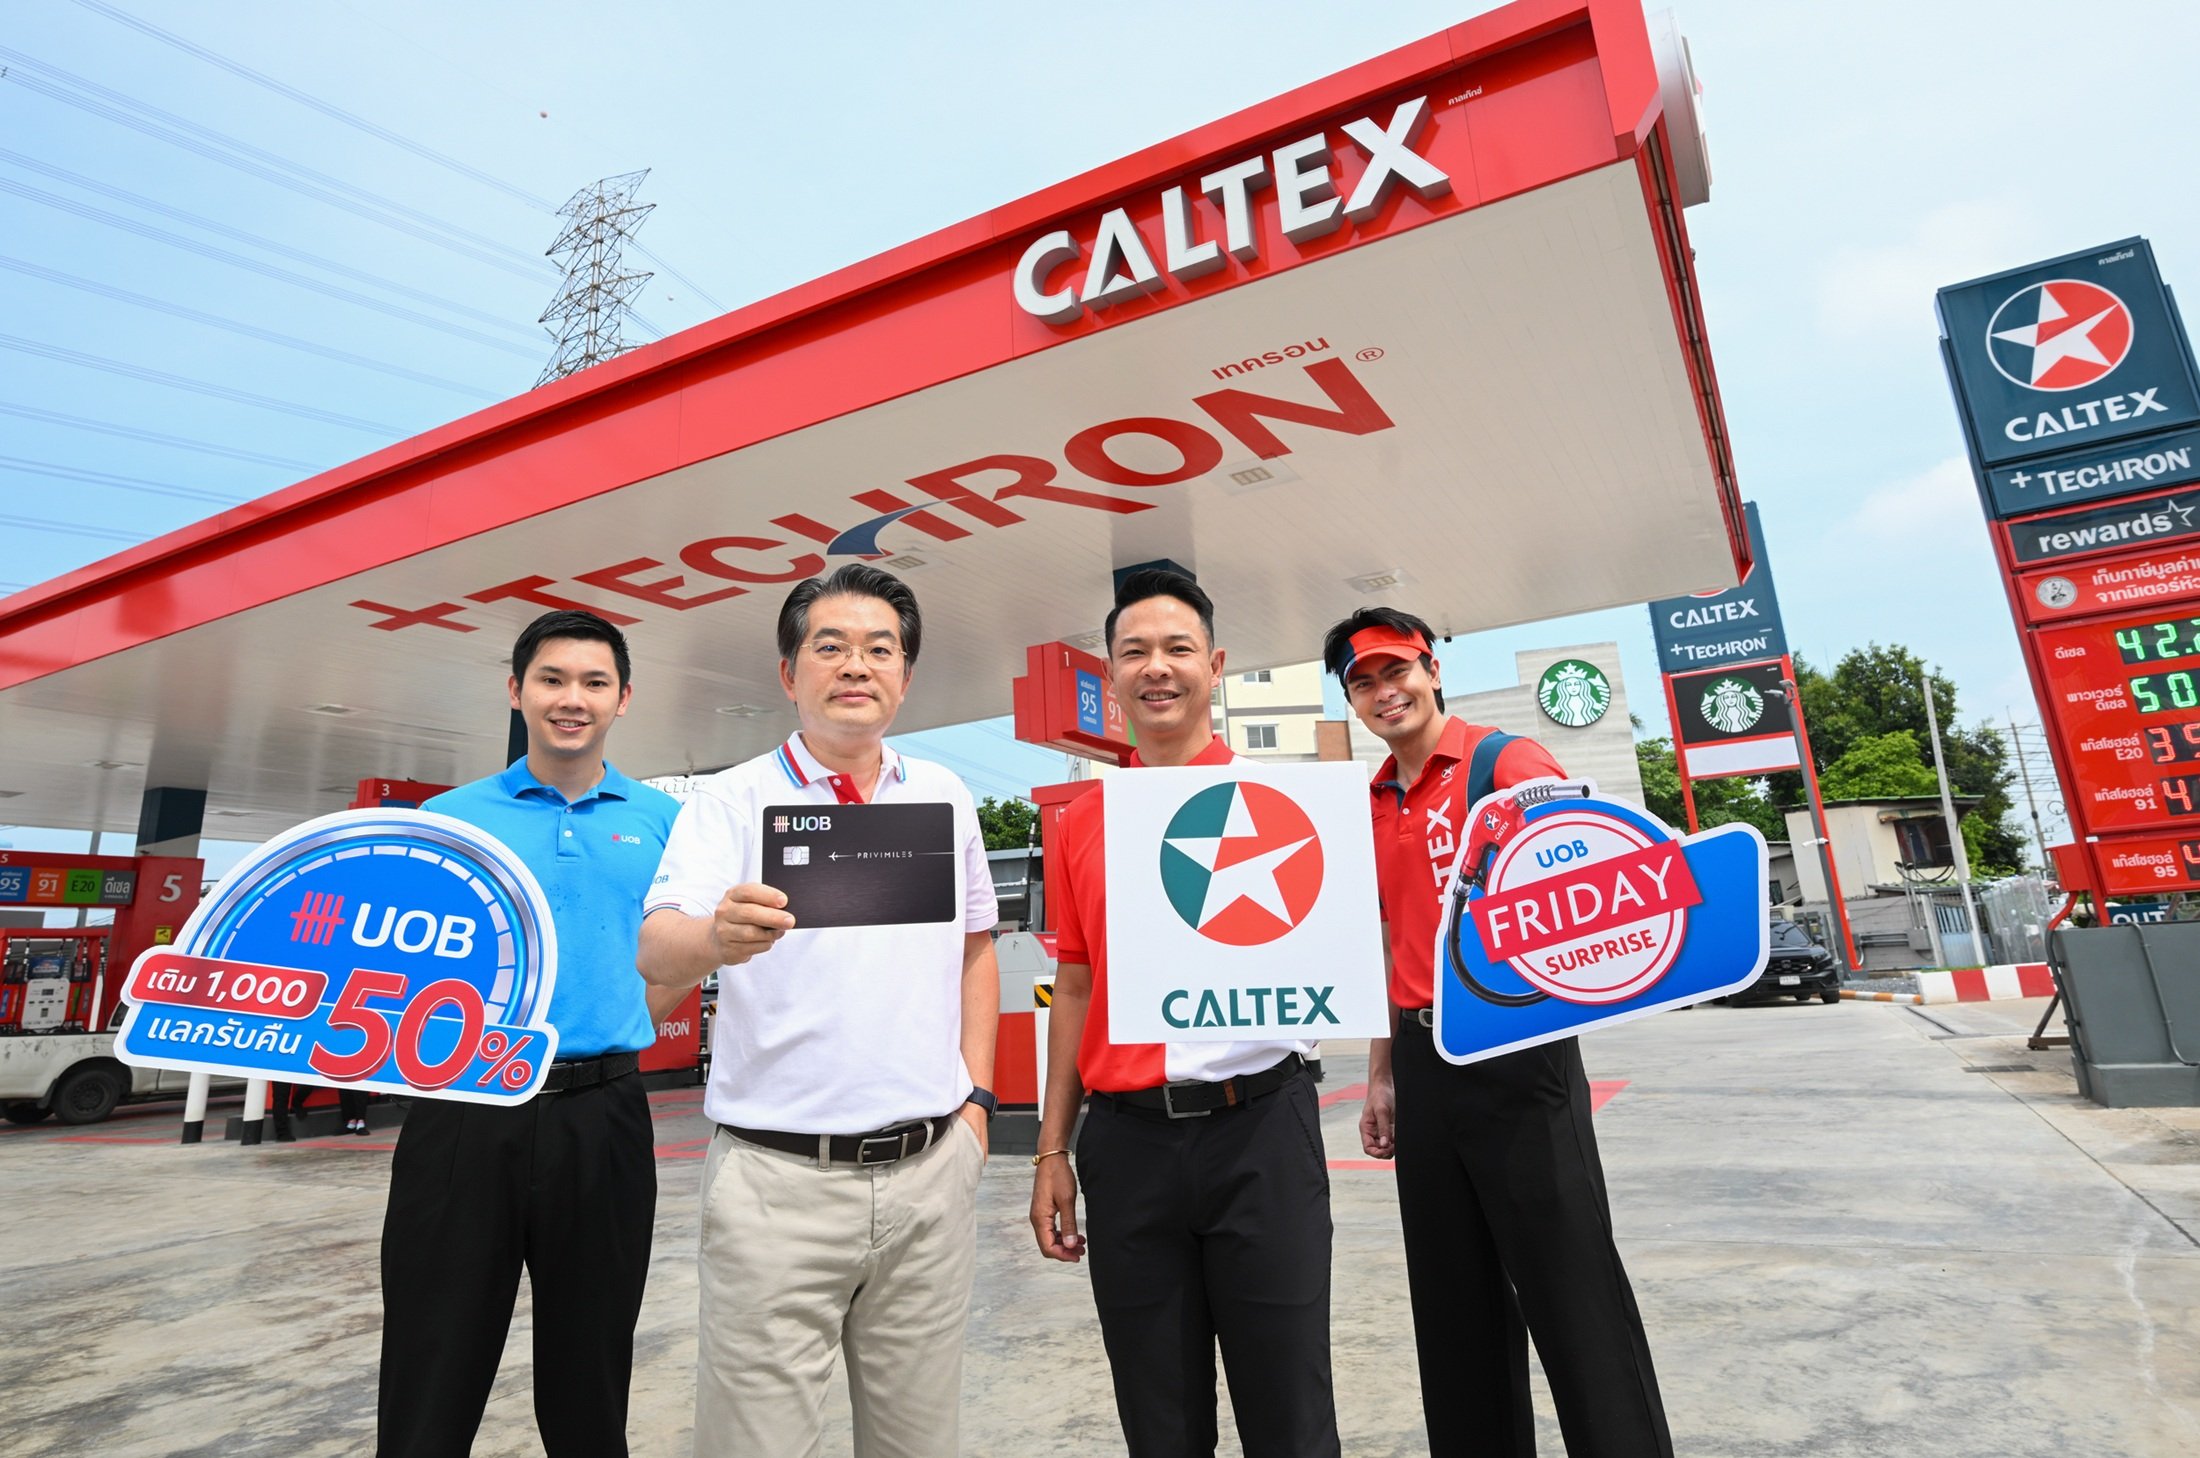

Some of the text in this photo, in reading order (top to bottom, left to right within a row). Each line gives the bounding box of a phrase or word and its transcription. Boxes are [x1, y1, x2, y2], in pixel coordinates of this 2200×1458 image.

[1013, 95, 1450, 324] CALTEX
[1211, 336, 1331, 380] เทครอน
[2004, 387, 2169, 442] CALTEX
[2037, 512, 2173, 553] rewards
[1669, 599, 1760, 629] CALTEX
[1064, 651, 1070, 667] 1
[2054, 646, 2086, 660] ดีเซล
[1081, 691, 1097, 715] 95
[2066, 684, 2123, 703] พาวเวอร์
[1108, 700, 1122, 724] 91
[2095, 697, 2127, 712] ดีเซล
[2115, 747, 2144, 761] E20
[381, 784, 390, 797] 3
[2134, 799, 2158, 811] 91
[792, 815, 832, 832] UOB
[1494, 822, 1510, 841] CALTEX
[621, 834, 641, 845] UOB
[1, 853, 9, 864] 5
[856, 850, 913, 859] PRIVIMILES
[1426, 796, 1455, 904] TEX
[1535, 839, 1590, 869] UOB
[654, 874, 669, 884] OB
[2153, 865, 2178, 878] 95
[0, 877, 21, 892] 95
[37, 878, 58, 893] 91
[104, 876, 131, 894] ดีเซล
[159, 874, 183, 903] 5
[1486, 855, 1674, 949] FRIDAY
[351, 902, 477, 960] UOB
[1545, 929, 1657, 976] SURPRISE
[146, 968, 308, 1008] เติม 1,000
[1161, 986, 1341, 1029] CALTEX
[147, 1015, 303, 1056] แลกรับคืน
